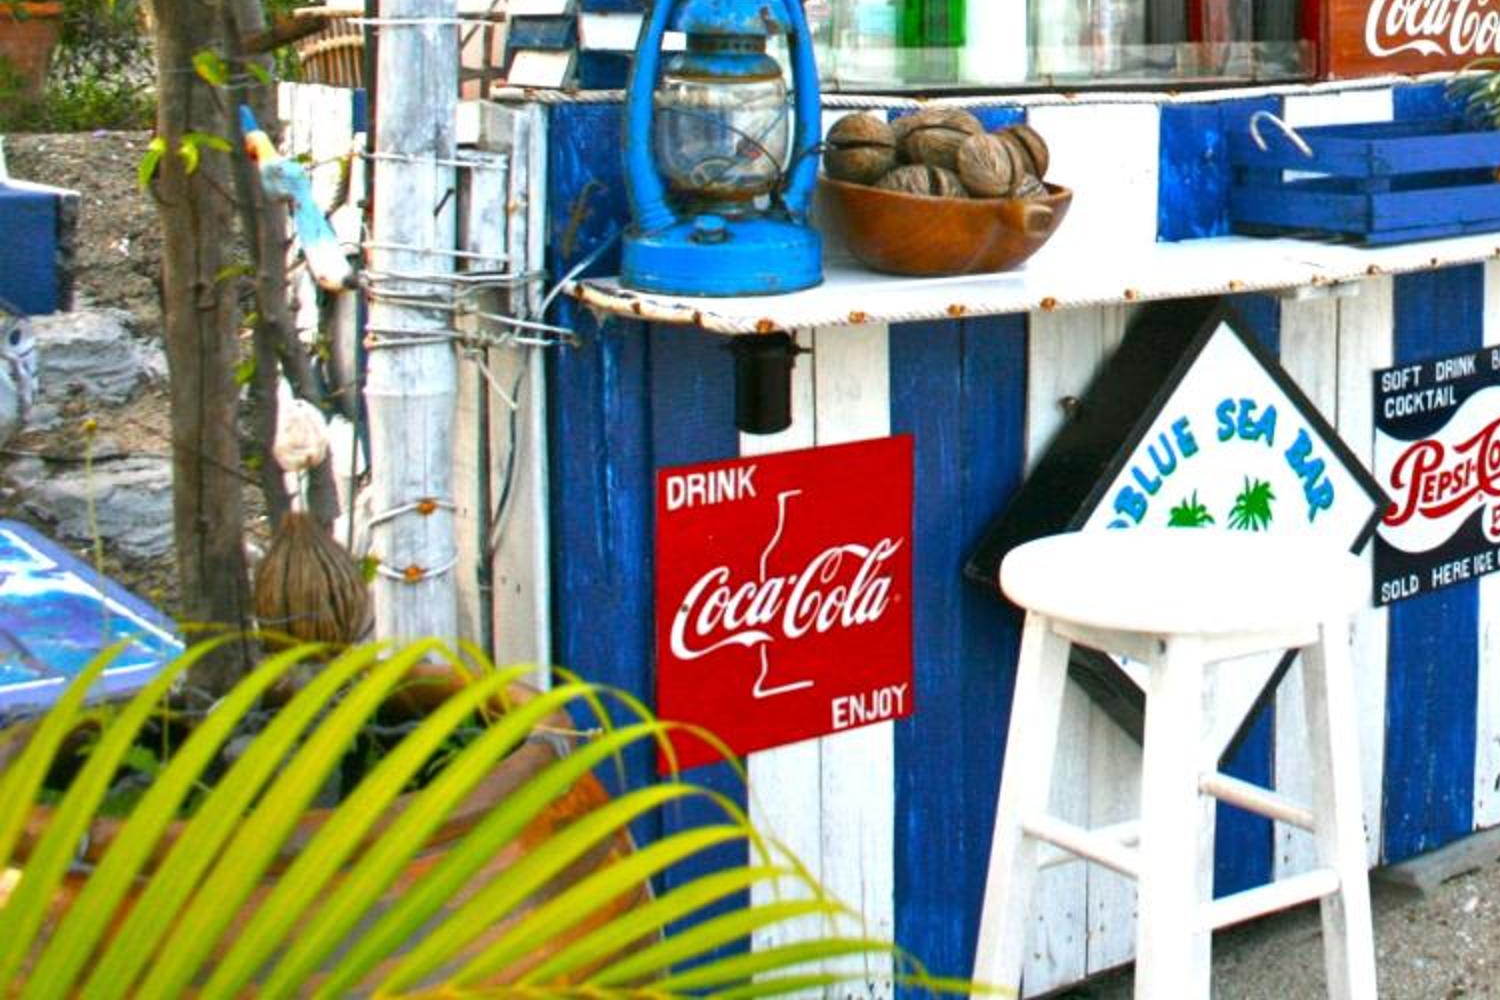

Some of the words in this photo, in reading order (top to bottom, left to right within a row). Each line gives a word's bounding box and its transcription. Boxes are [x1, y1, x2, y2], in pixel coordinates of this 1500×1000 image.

[1381, 365, 1423, 393] SOFT
[1435, 353, 1477, 382] DRINK
[1384, 385, 1457, 420] COCKTAIL
[1113, 415, 1200, 526] BLUE
[1215, 397, 1279, 448] SEA
[1284, 427, 1336, 524] BAR
[666, 464, 758, 512] DRINK
[669, 536, 904, 661] Coca-Cola
[1381, 573, 1420, 603] SOLD
[1431, 556, 1471, 589] HERE
[1473, 550, 1495, 575] ICE
[831, 682, 908, 730] ENJOY
